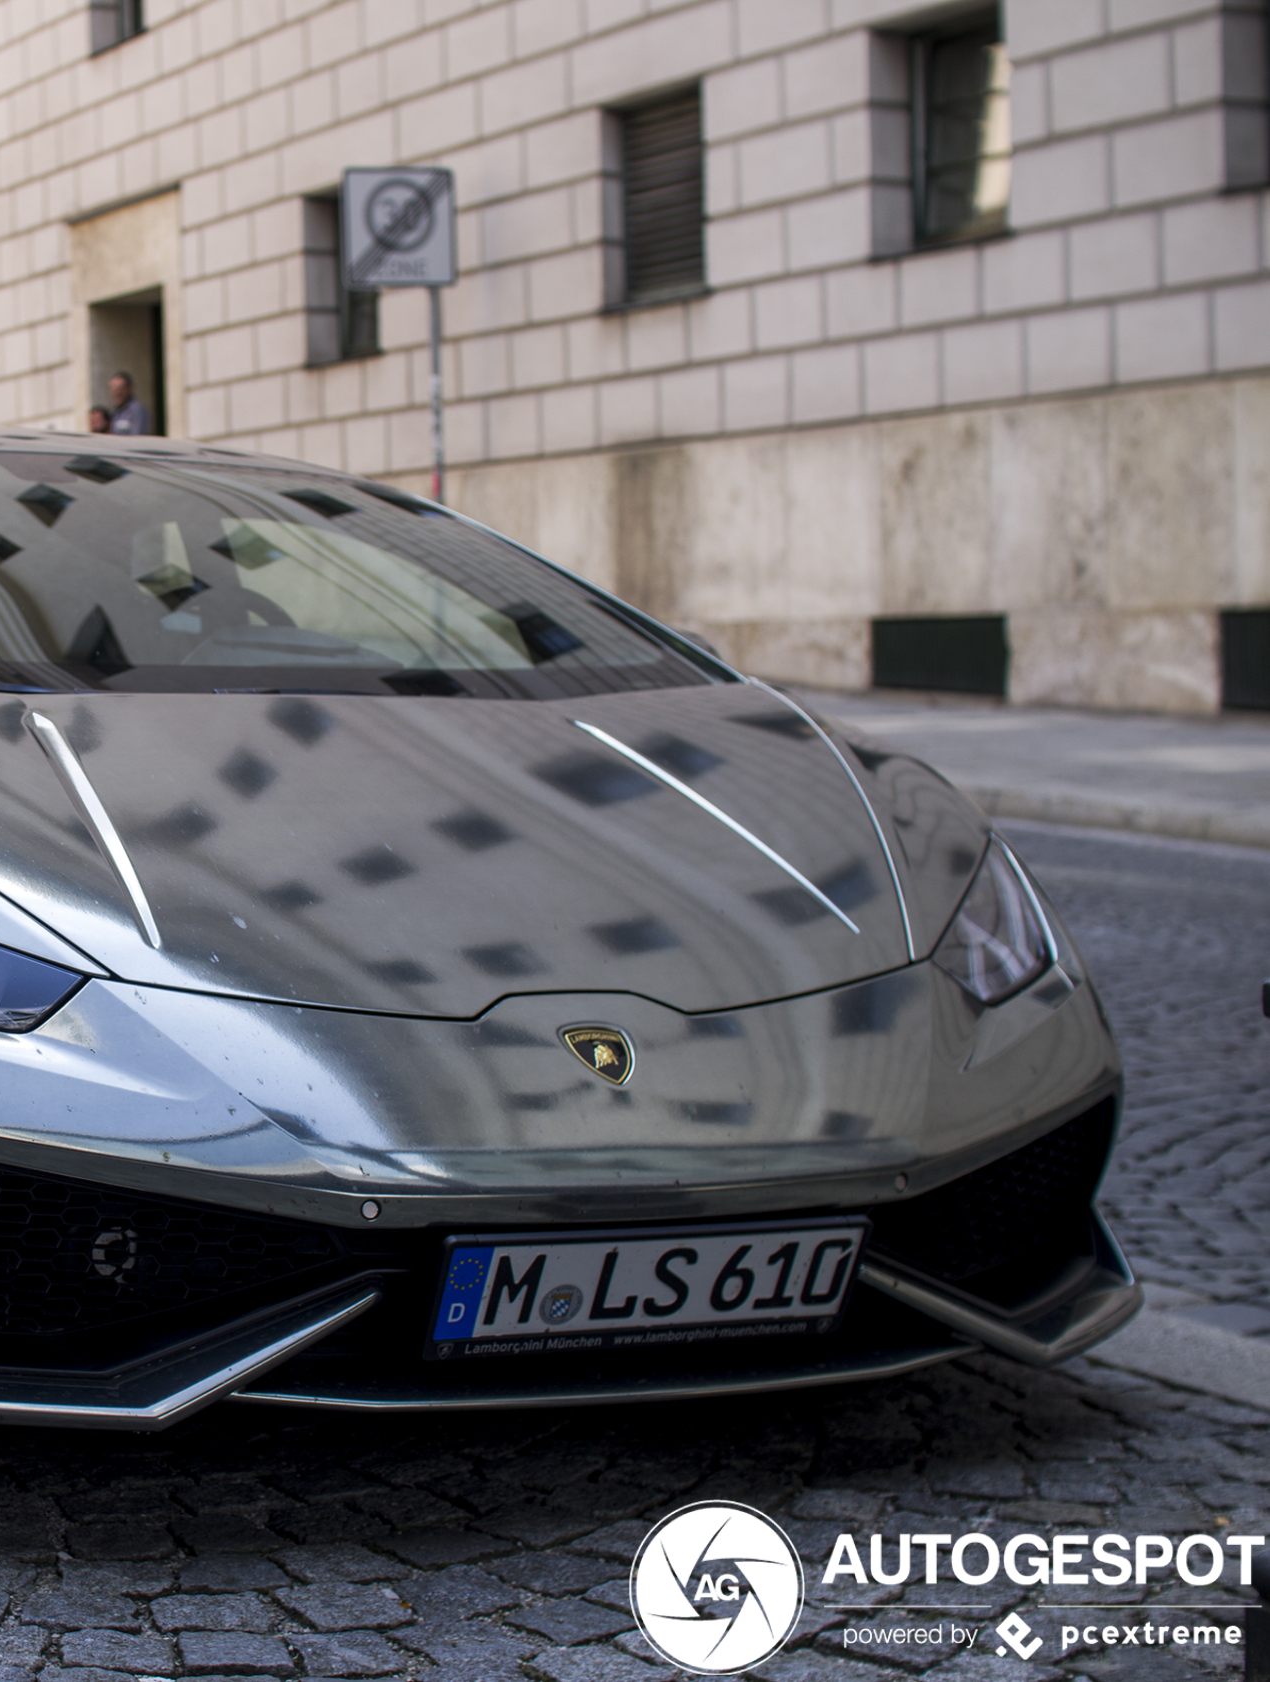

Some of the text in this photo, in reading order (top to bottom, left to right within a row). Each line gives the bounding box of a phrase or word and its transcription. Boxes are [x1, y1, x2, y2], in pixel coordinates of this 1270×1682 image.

[447, 1302, 465, 1323] D
[482, 1254, 547, 1325] M
[589, 1247, 698, 1320] LS
[709, 1238, 853, 1311] 610
[546, 1336, 603, 1350] München
[613, 1321, 807, 1346] www.lamborghini-muenchen.com
